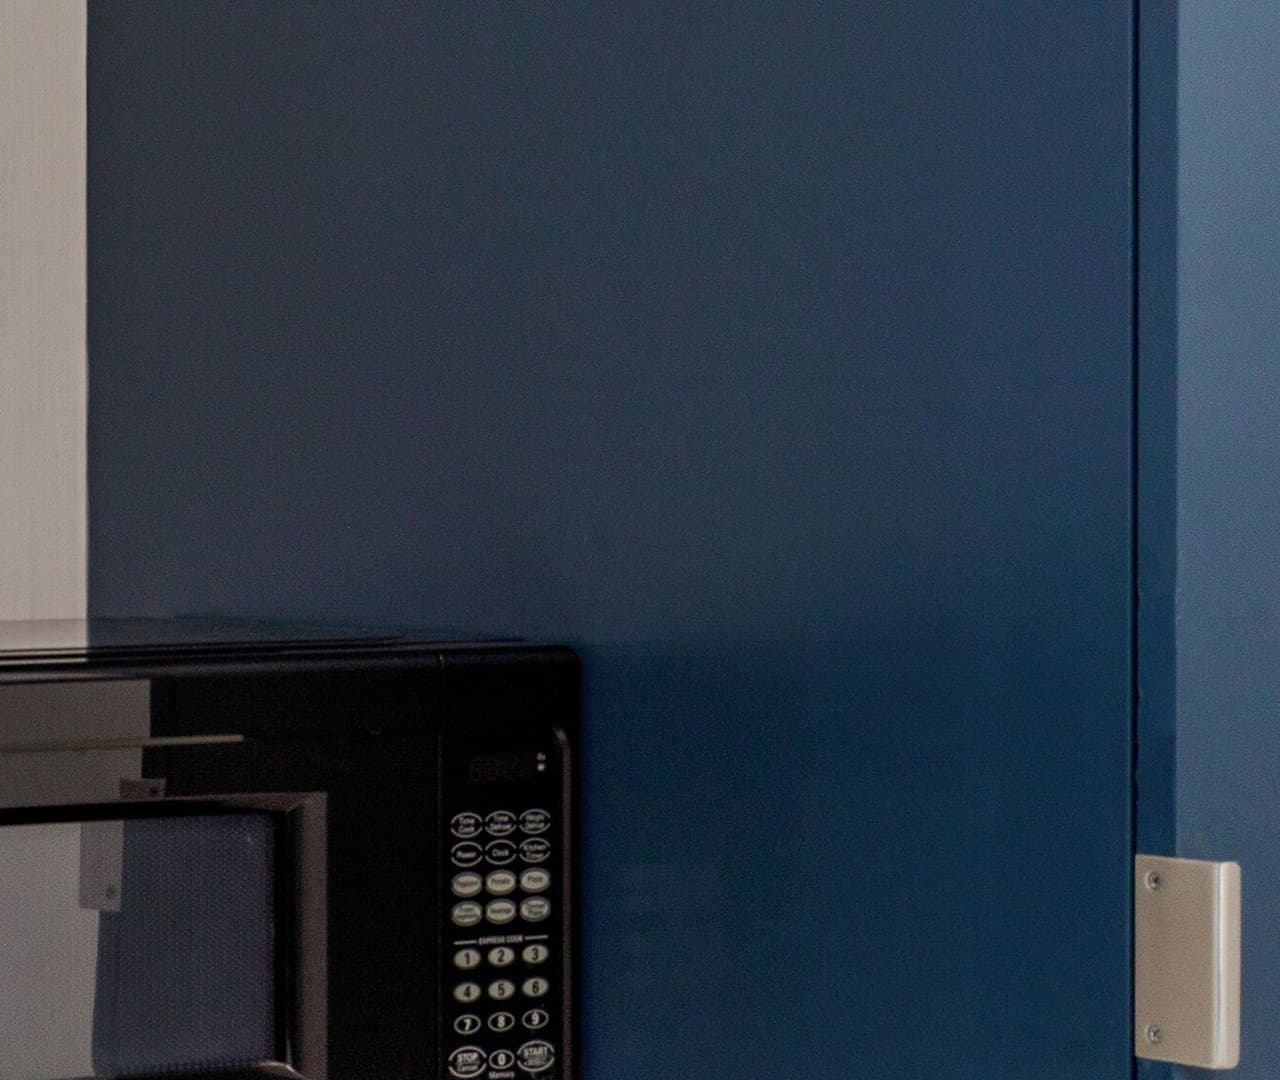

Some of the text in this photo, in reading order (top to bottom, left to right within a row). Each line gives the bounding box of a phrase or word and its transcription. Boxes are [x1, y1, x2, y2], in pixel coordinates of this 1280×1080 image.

[464, 952, 471, 965] 1
[497, 949, 505, 962] 2
[531, 947, 539, 960] 3
[463, 986, 471, 998] 4
[497, 983, 505, 996] 5
[531, 981, 539, 993] 6
[464, 1018, 471, 1030] 7
[497, 1015, 505, 1027] 8
[531, 1012, 539, 1025] 9
[457, 1052, 478, 1063] STOP
[523, 1046, 548, 1058] START
[497, 1053, 506, 1066] 0
